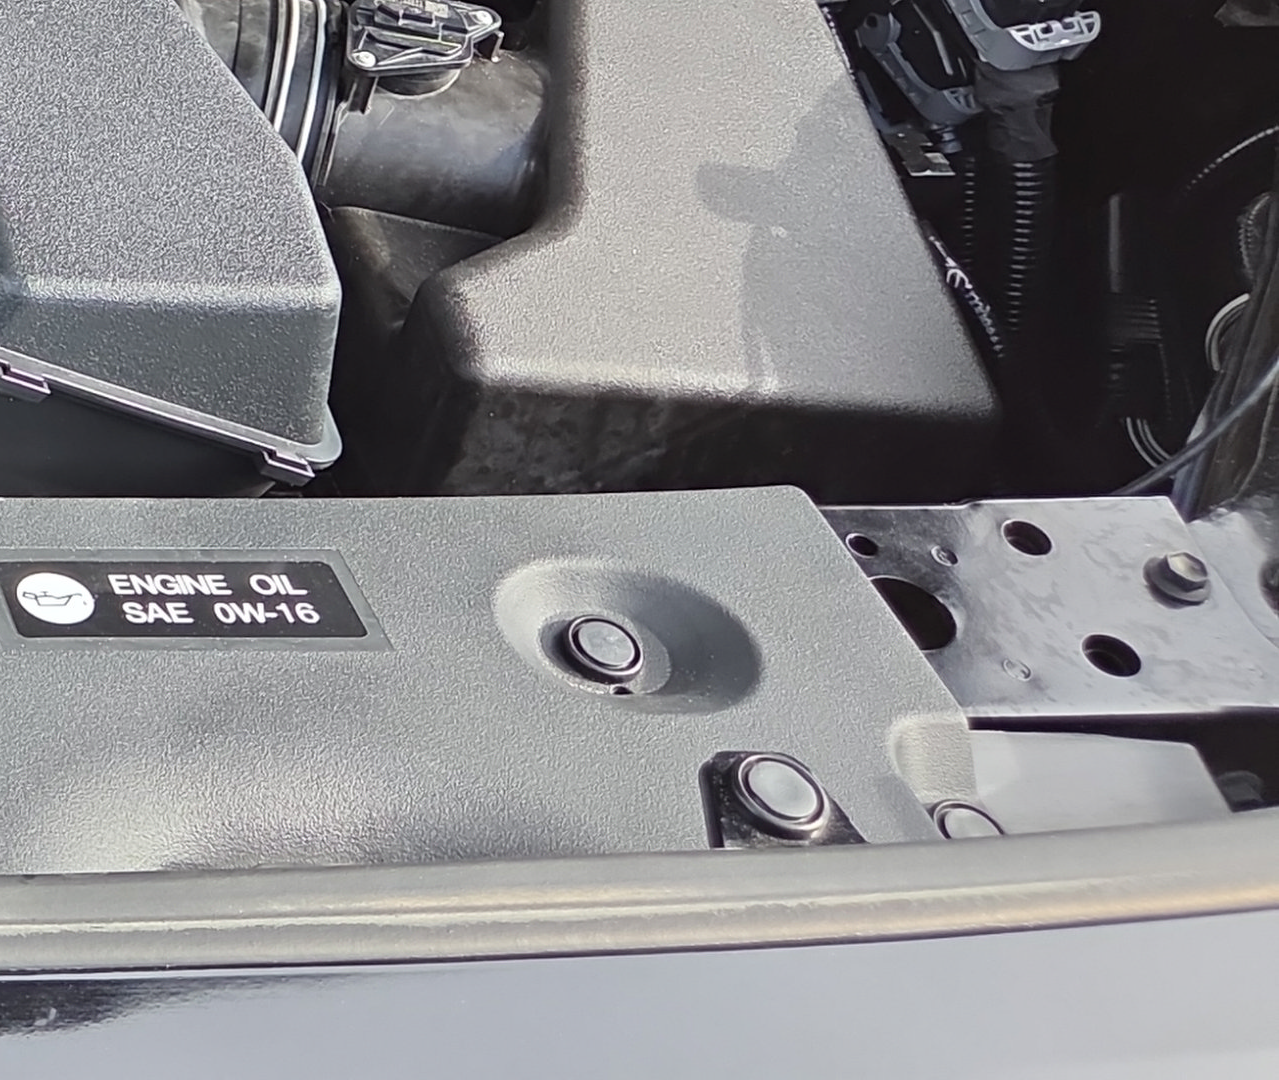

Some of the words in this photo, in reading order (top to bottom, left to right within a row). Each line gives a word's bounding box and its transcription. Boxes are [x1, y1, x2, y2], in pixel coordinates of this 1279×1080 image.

[107, 574, 233, 596] ENGINE
[249, 574, 309, 596] OIL
[121, 601, 194, 624] SAE
[212, 601, 321, 624] 0W-16
